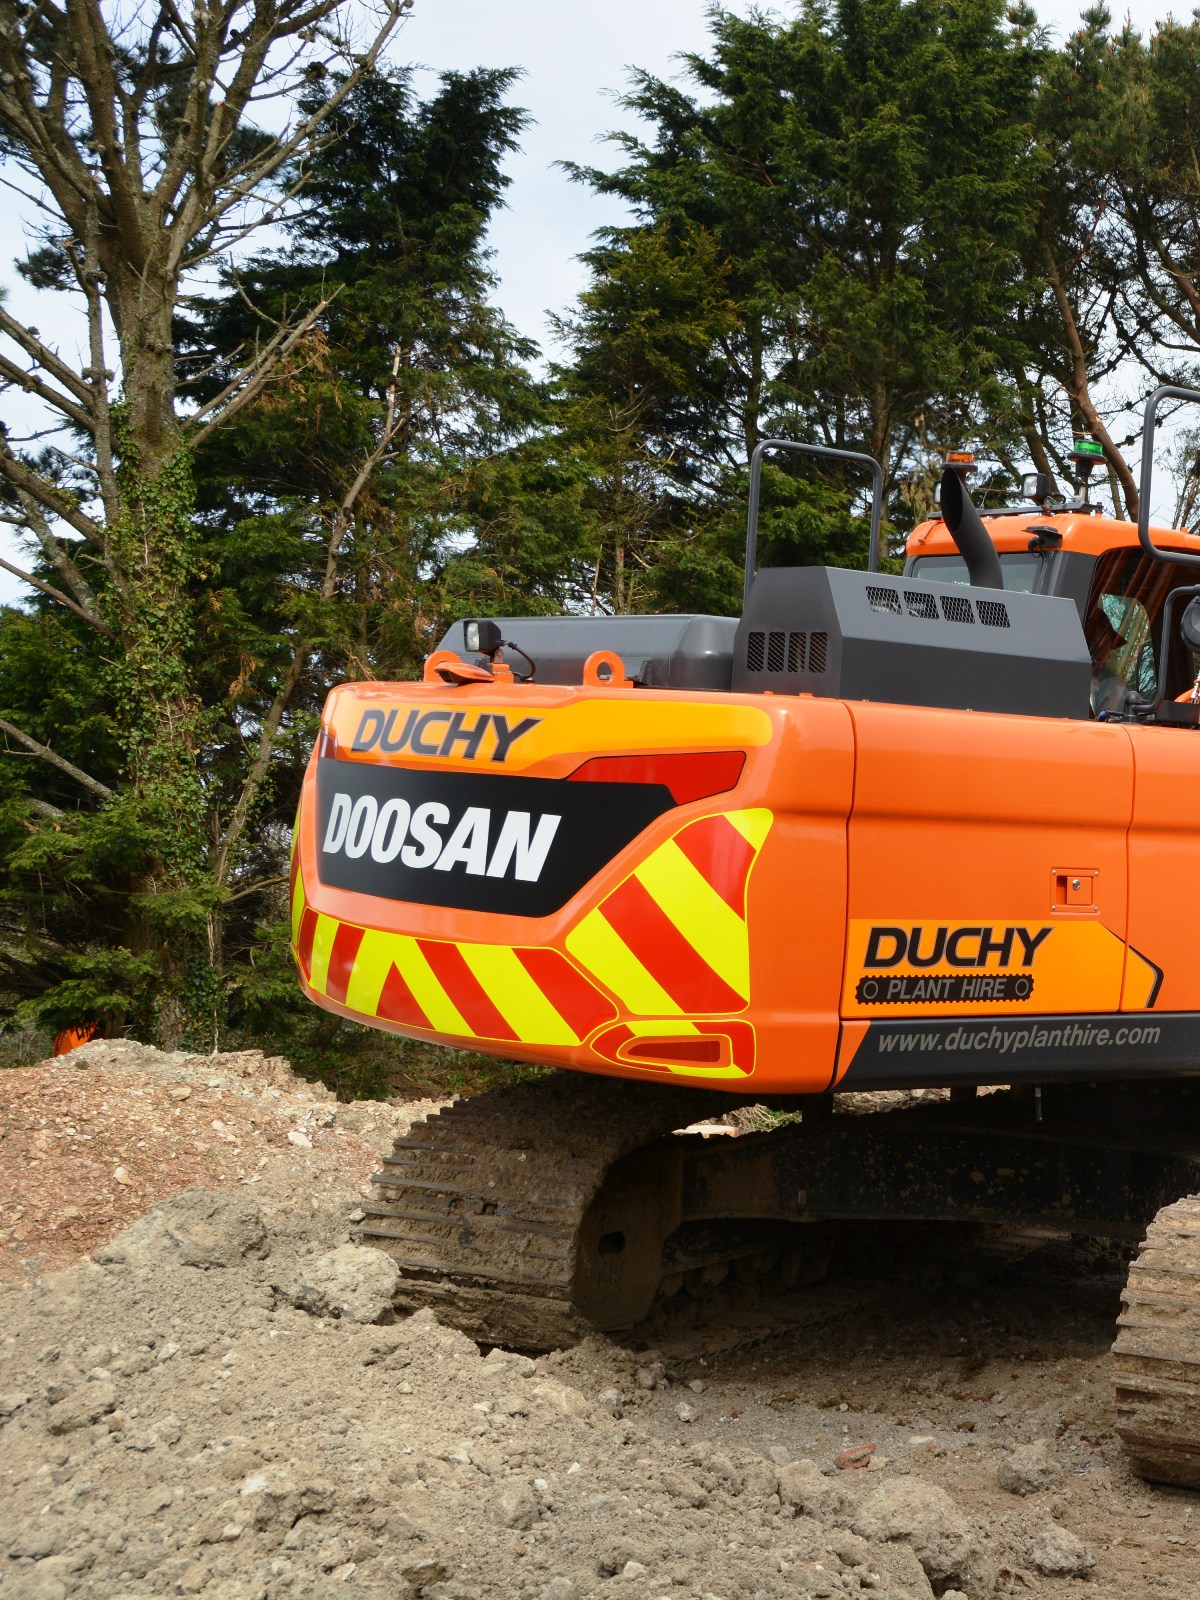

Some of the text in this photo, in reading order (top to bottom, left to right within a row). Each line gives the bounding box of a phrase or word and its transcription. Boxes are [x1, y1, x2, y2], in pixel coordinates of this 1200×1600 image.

[351, 708, 544, 763] DUCHY
[322, 792, 561, 882] DOOSAN
[862, 926, 1055, 968] DUCHY
[886, 978, 1007, 999] PLANT HIRE
[878, 1024, 1161, 1053] www.duchyplanthire.com
